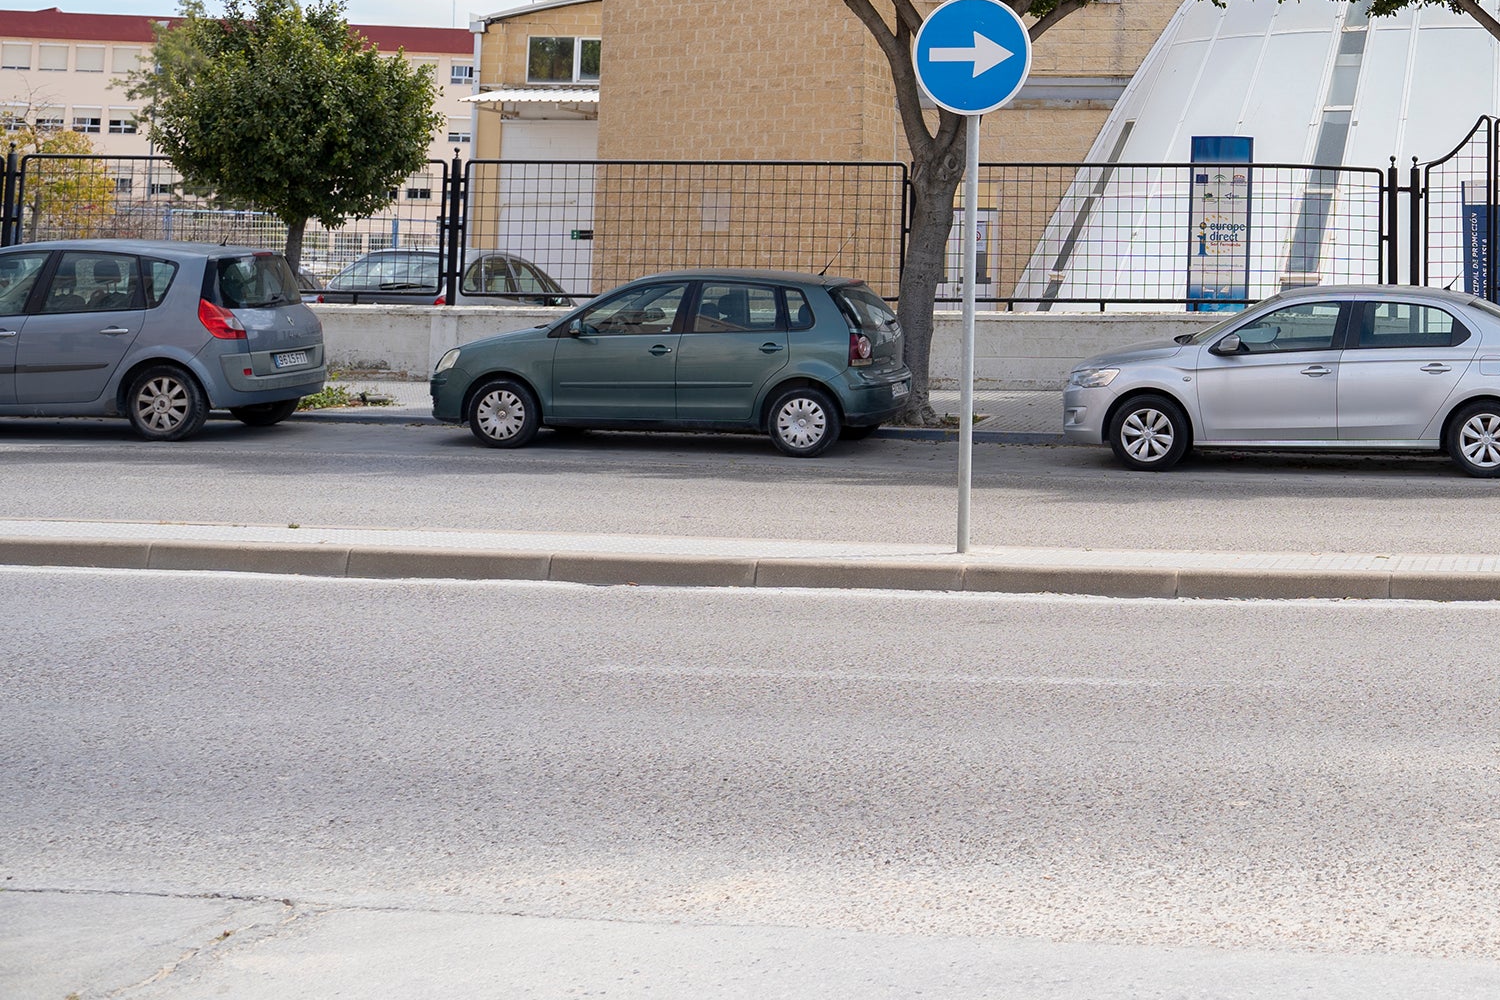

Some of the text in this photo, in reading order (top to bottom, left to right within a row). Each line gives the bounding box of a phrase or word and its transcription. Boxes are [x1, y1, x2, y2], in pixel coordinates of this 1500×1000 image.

[1209, 222, 1246, 233] europe
[1470, 212, 1479, 258] PROMOCIÓN
[1209, 231, 1239, 242] direct
[1472, 272, 1480, 296] ICIPAL
